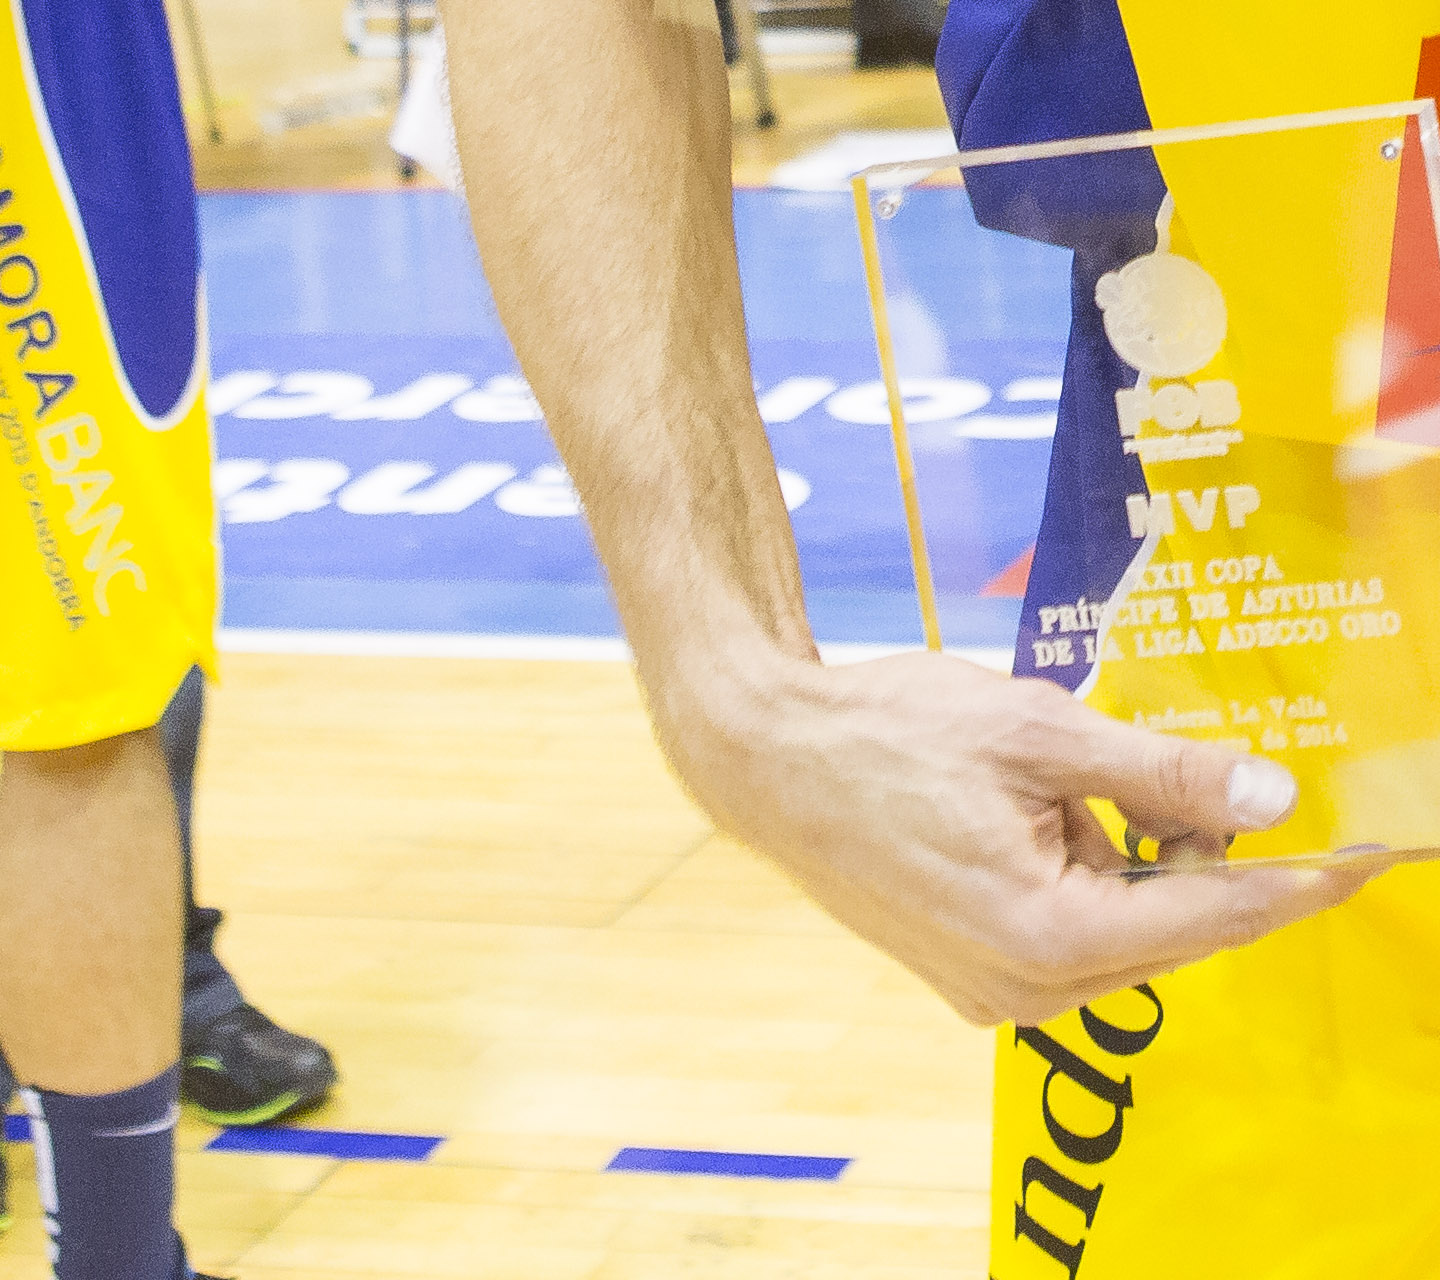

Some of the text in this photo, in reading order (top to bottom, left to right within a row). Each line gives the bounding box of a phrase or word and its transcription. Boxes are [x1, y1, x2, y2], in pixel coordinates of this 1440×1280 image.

[1125, 484, 1261, 539] MVP
[1205, 554, 1283, 586] COPA
[1189, 591, 1230, 621] DE
[1241, 577, 1385, 615] ASTURIAS
[1032, 609, 1402, 667] DE LA LIGA ADECCO ORO
